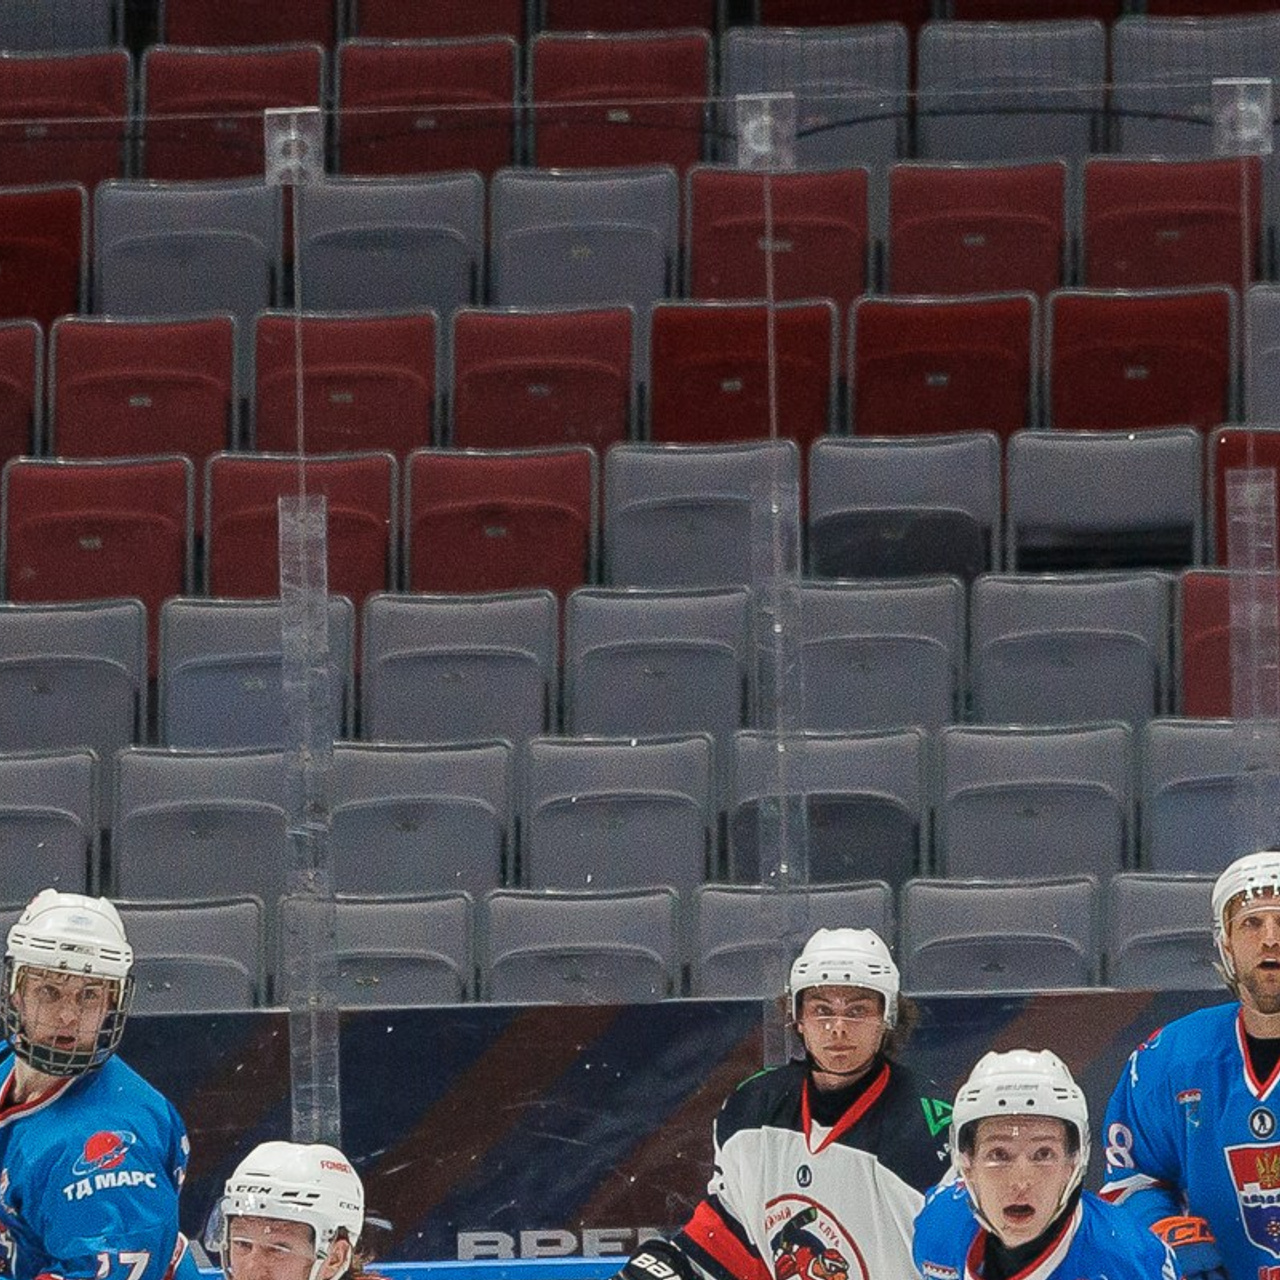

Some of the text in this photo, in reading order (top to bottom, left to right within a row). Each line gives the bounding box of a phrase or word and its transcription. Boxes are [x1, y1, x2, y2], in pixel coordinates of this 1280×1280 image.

[95, 1170, 157, 1190] МАРС
[236, 1185, 272, 1195] CCM
[338, 1201, 360, 1212] CCM
